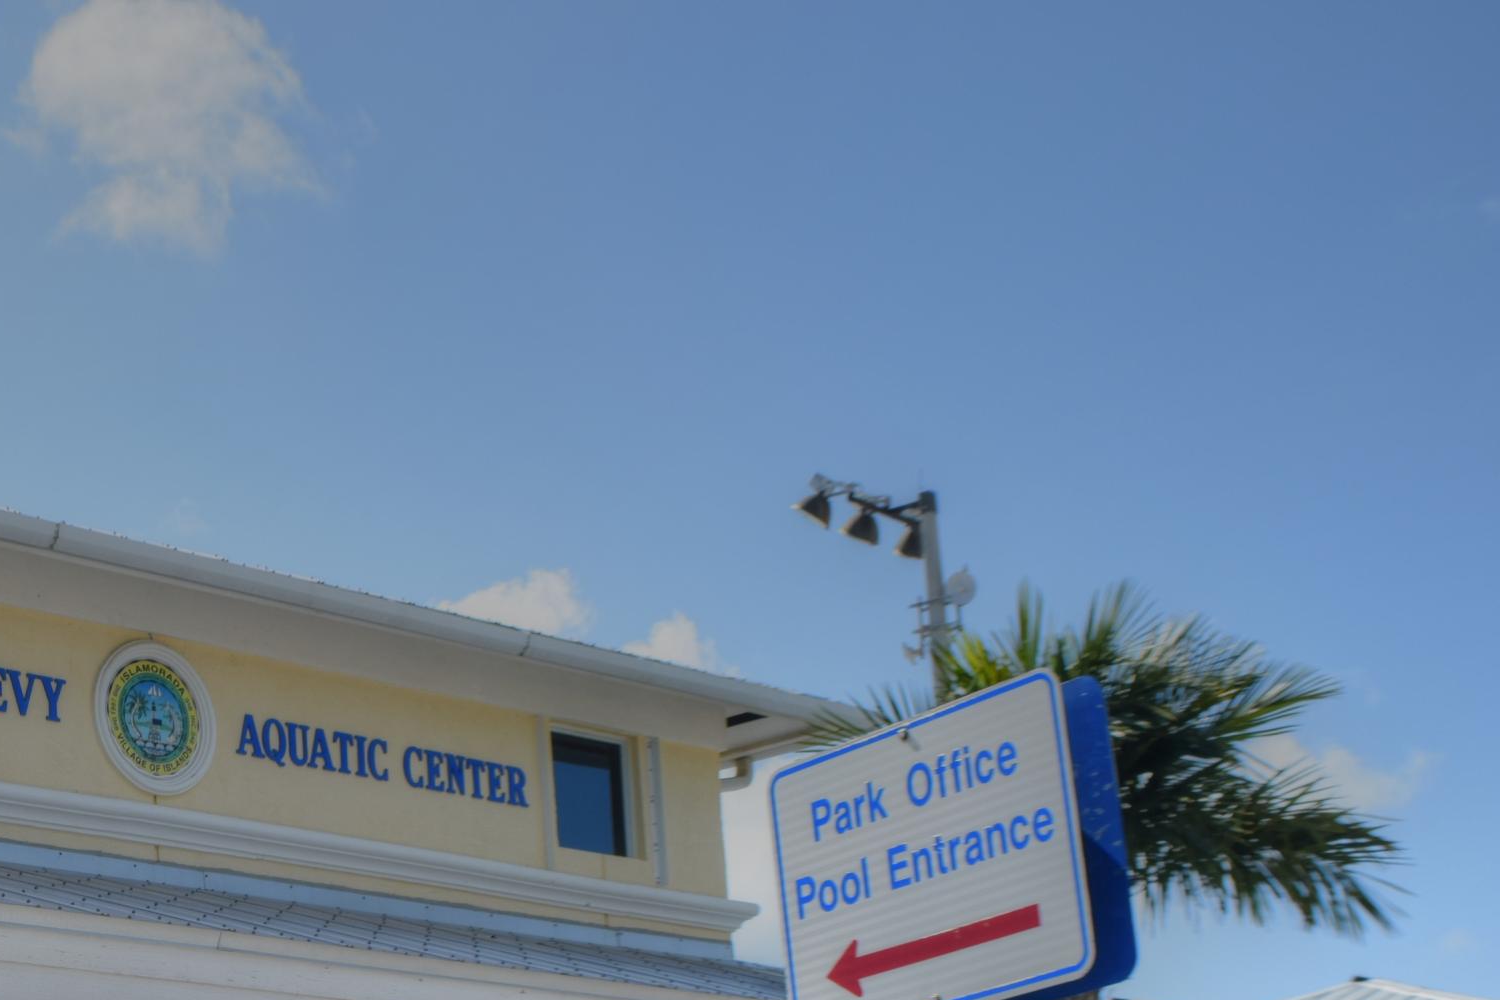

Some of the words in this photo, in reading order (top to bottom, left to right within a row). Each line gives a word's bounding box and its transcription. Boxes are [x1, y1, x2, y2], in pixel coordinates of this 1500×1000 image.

[120, 664, 185, 697] ISLAMORADA
[117, 733, 147, 769] VILLAGE
[149, 763, 162, 772] OF
[162, 747, 193, 773] ISLANDS
[235, 712, 389, 782] AQUATIC
[402, 745, 530, 808] CENTER
[810, 780, 889, 842] Park
[906, 741, 1018, 807] Office
[795, 856, 872, 920] Pool
[887, 807, 1055, 890] Entrance
